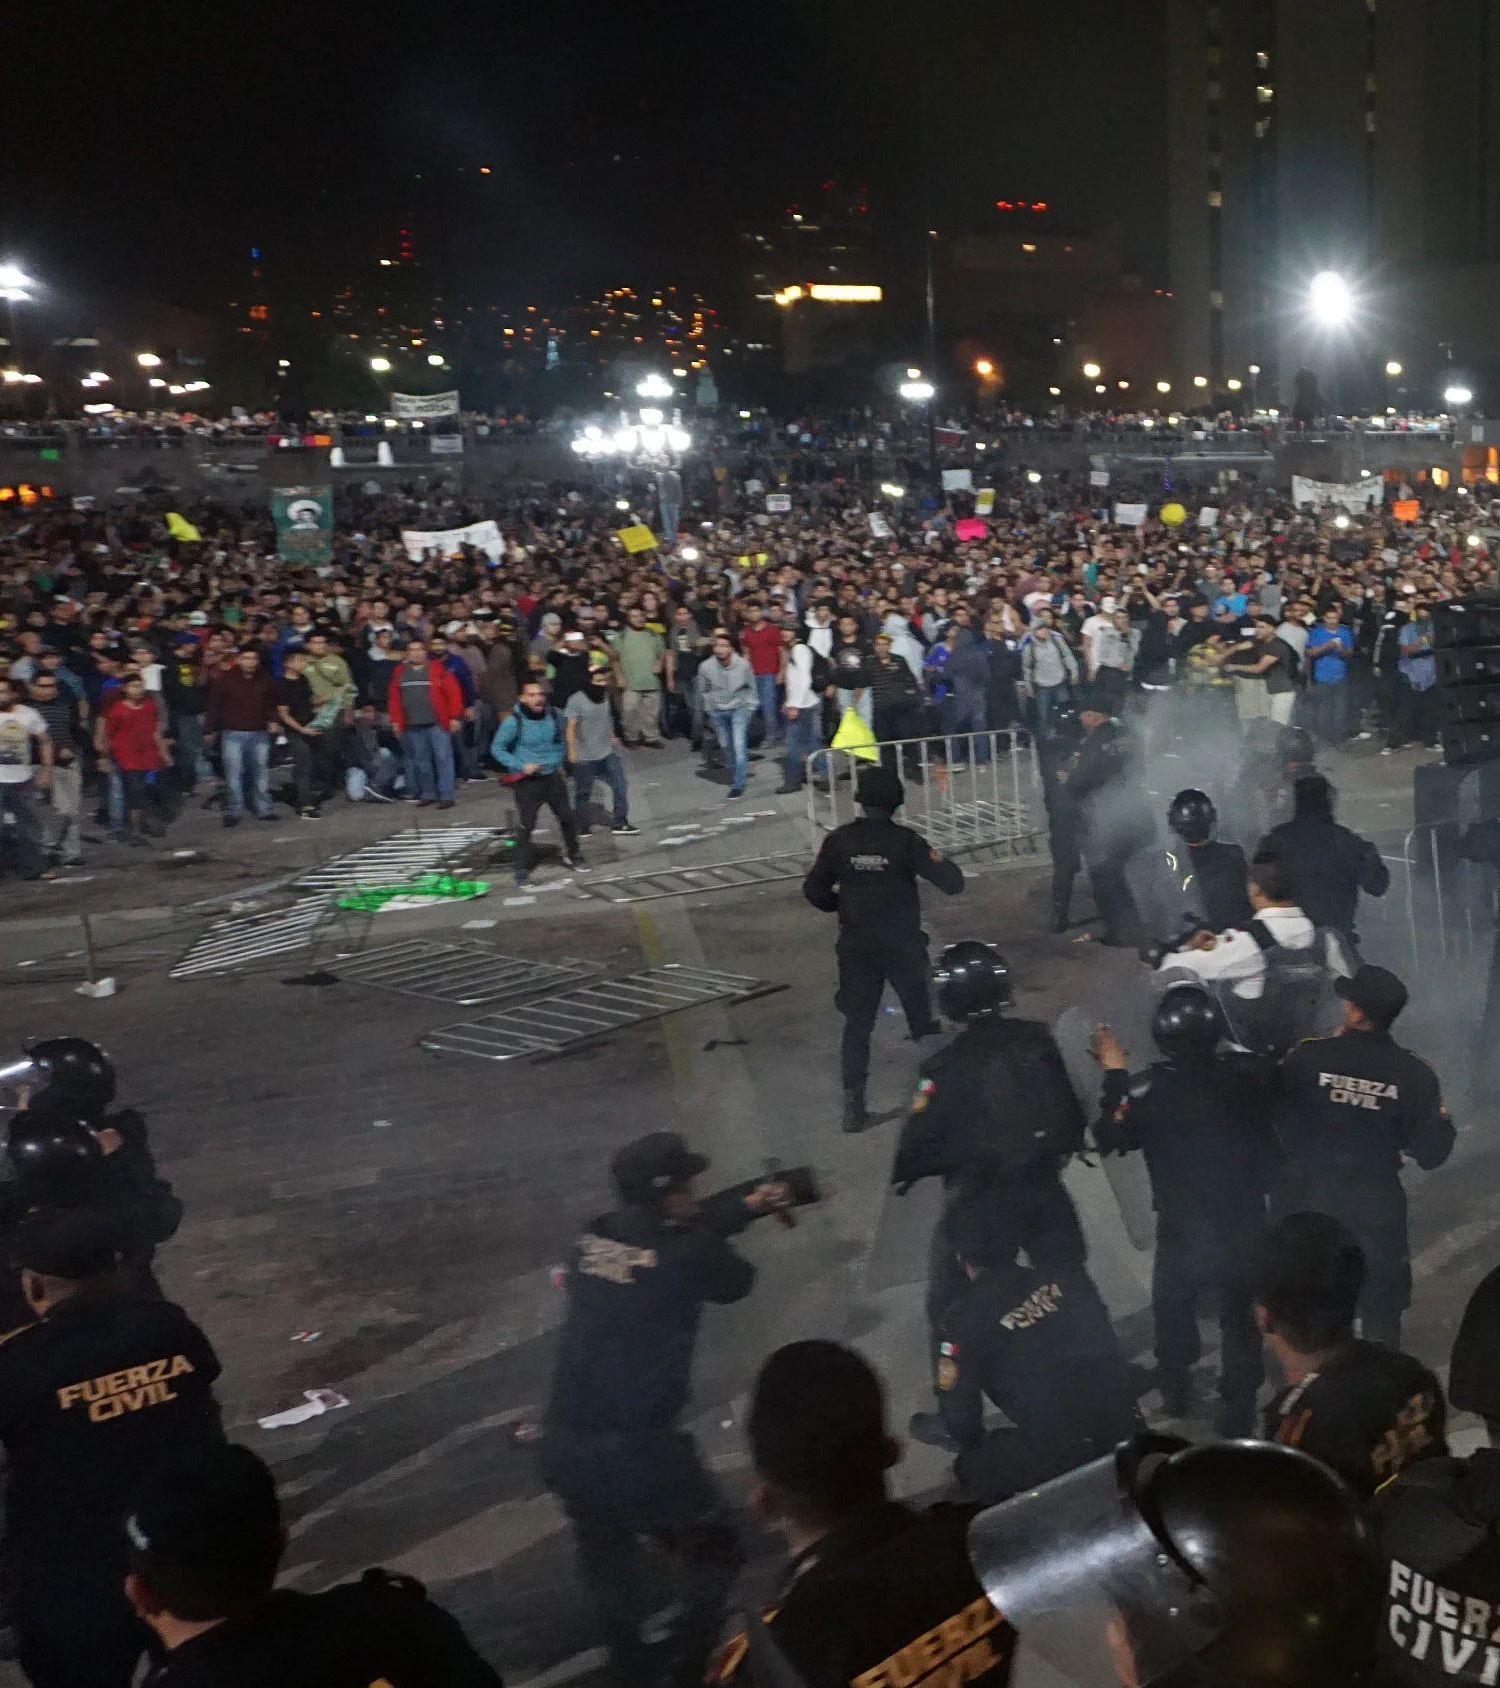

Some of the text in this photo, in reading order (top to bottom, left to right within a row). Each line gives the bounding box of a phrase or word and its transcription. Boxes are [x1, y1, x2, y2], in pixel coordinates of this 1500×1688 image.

[1319, 1072, 1399, 1100] FUERZA
[1329, 1088, 1381, 1110] CIVIL
[57, 1354, 195, 1410] FUERZA
[88, 1380, 179, 1423] CIVIL
